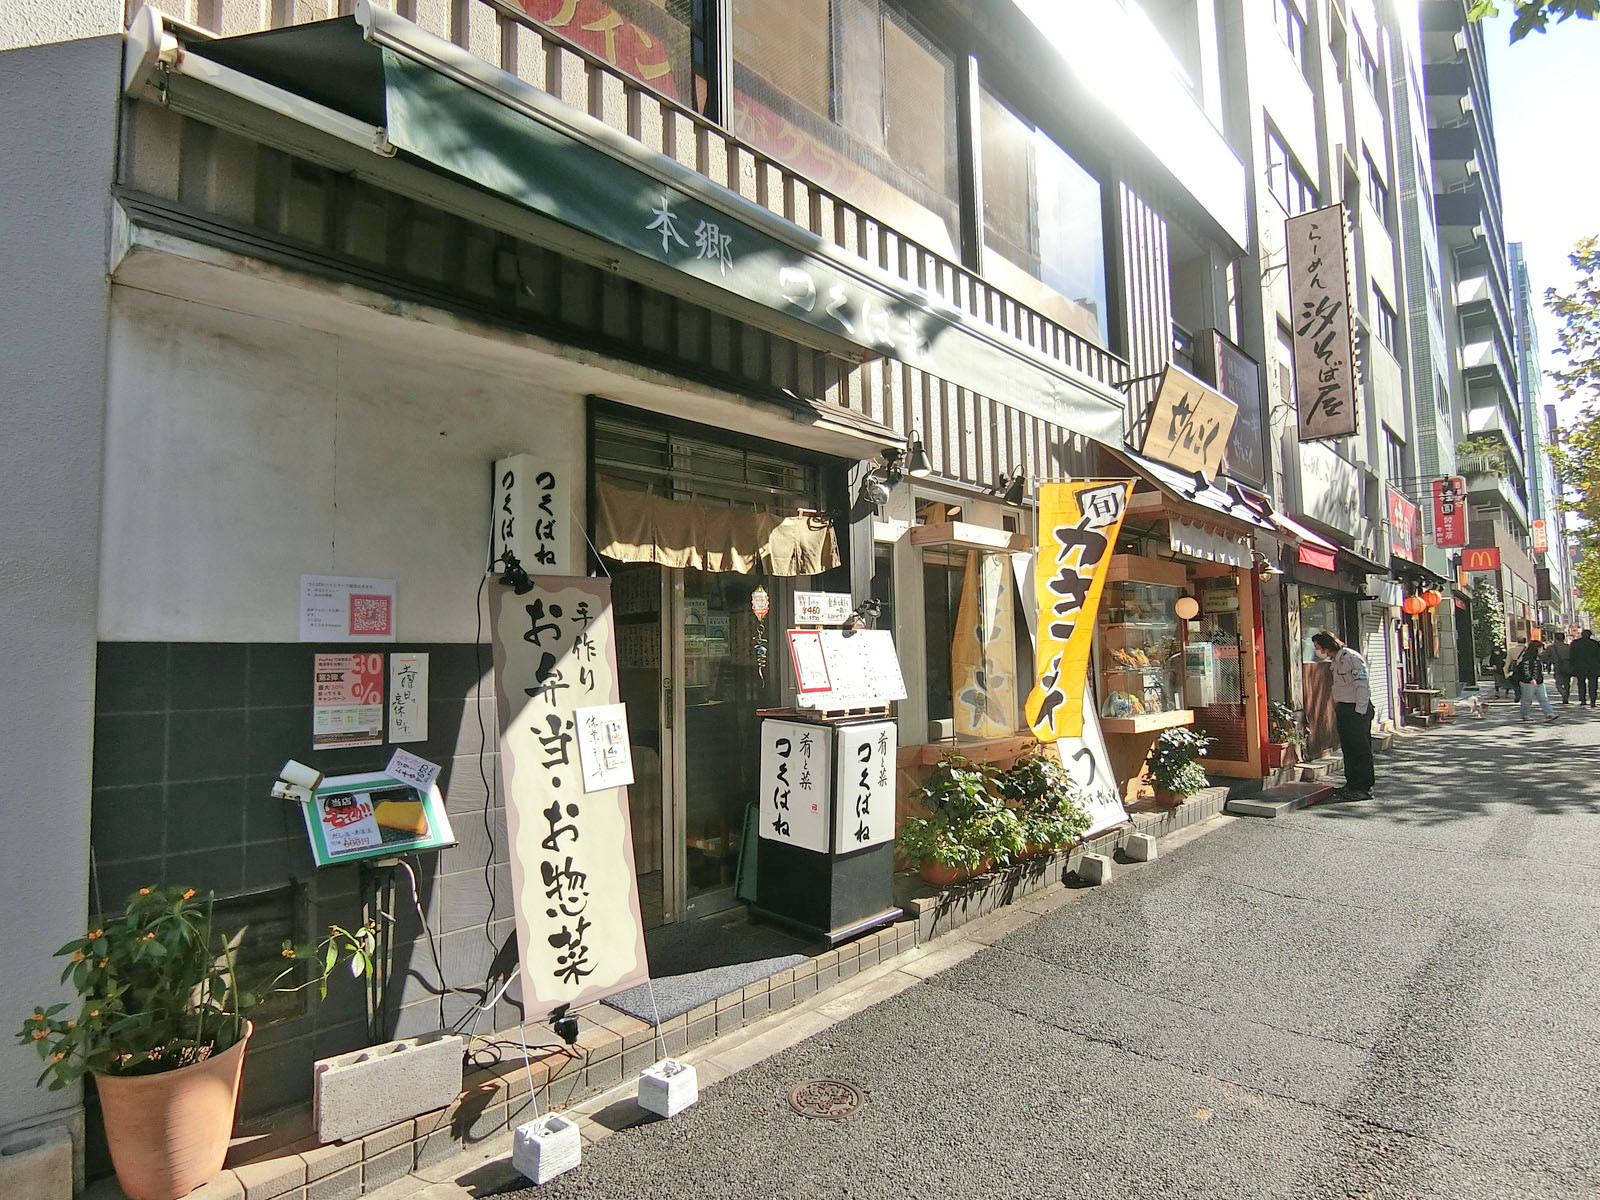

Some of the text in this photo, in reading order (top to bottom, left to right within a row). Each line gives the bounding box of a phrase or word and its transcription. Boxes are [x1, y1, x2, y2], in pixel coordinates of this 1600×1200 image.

[645, 196, 733, 277] 本郷
[1307, 223, 1327, 290] らーめん
[534, 471, 557, 566] つくばね
[1087, 491, 1120, 519] 旬
[351, 653, 382, 675] 30
[570, 601, 598, 695] 手作り
[523, 597, 600, 986] お弁当・お惣菜
[771, 737, 792, 838] つくばね
[799, 732, 813, 792] 肴と菜
[854, 742, 873, 843] つくばね
[877, 730, 889, 788] 肴と菜
